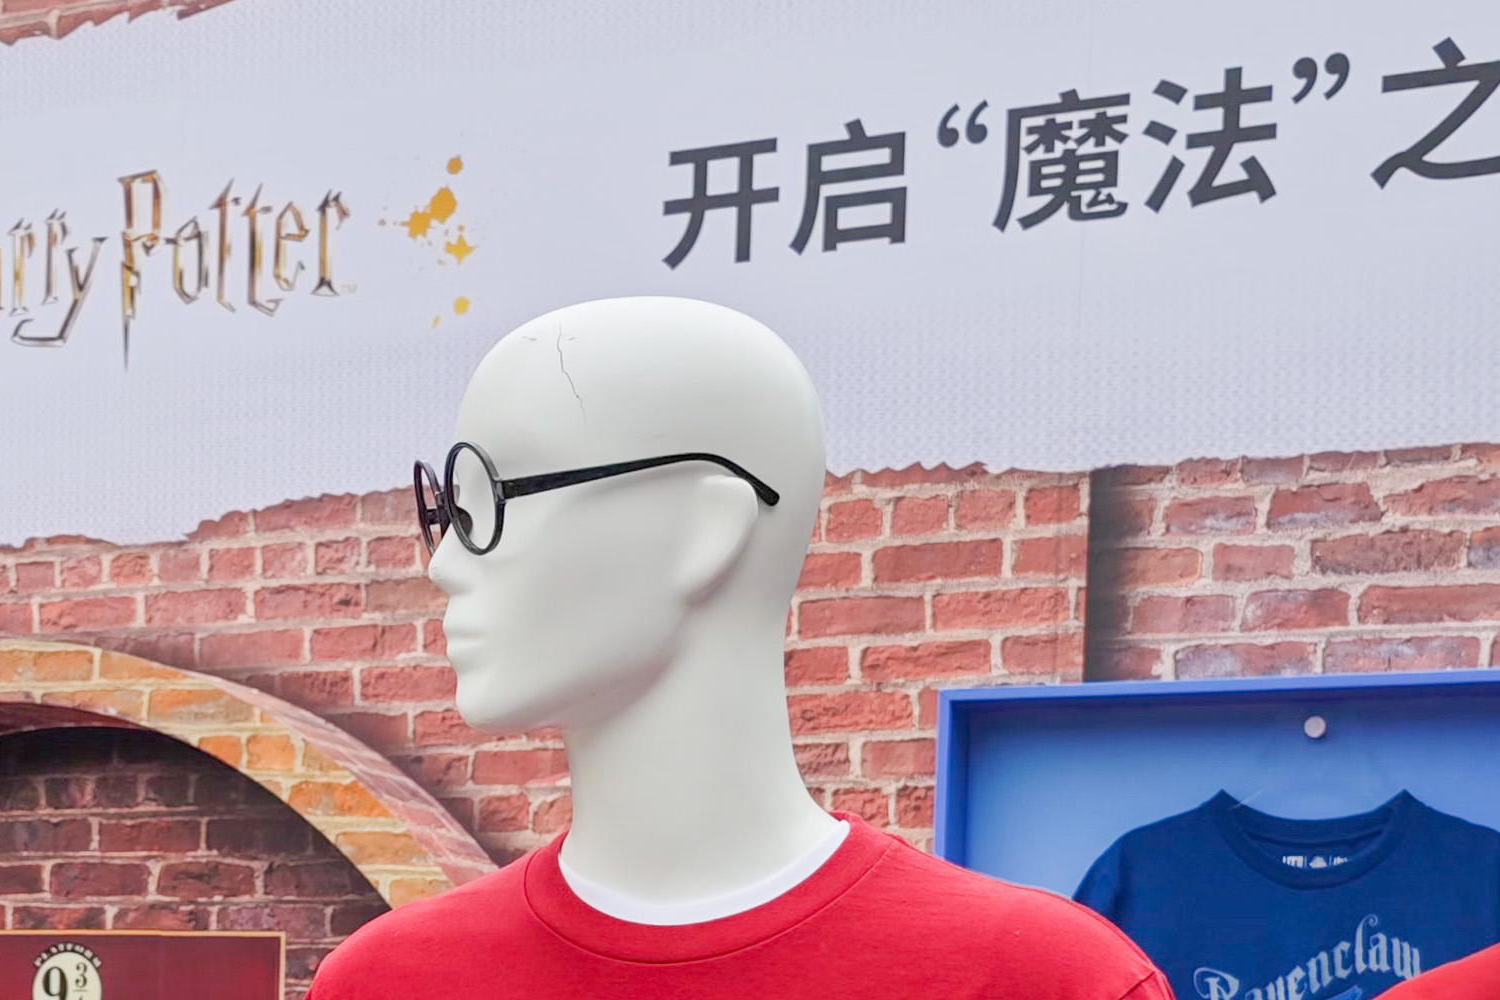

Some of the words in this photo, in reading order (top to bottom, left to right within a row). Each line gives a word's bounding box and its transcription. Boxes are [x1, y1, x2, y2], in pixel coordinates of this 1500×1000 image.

[662, 37, 1500, 270] 开启“魔法”之
[117, 169, 351, 372] Potter
